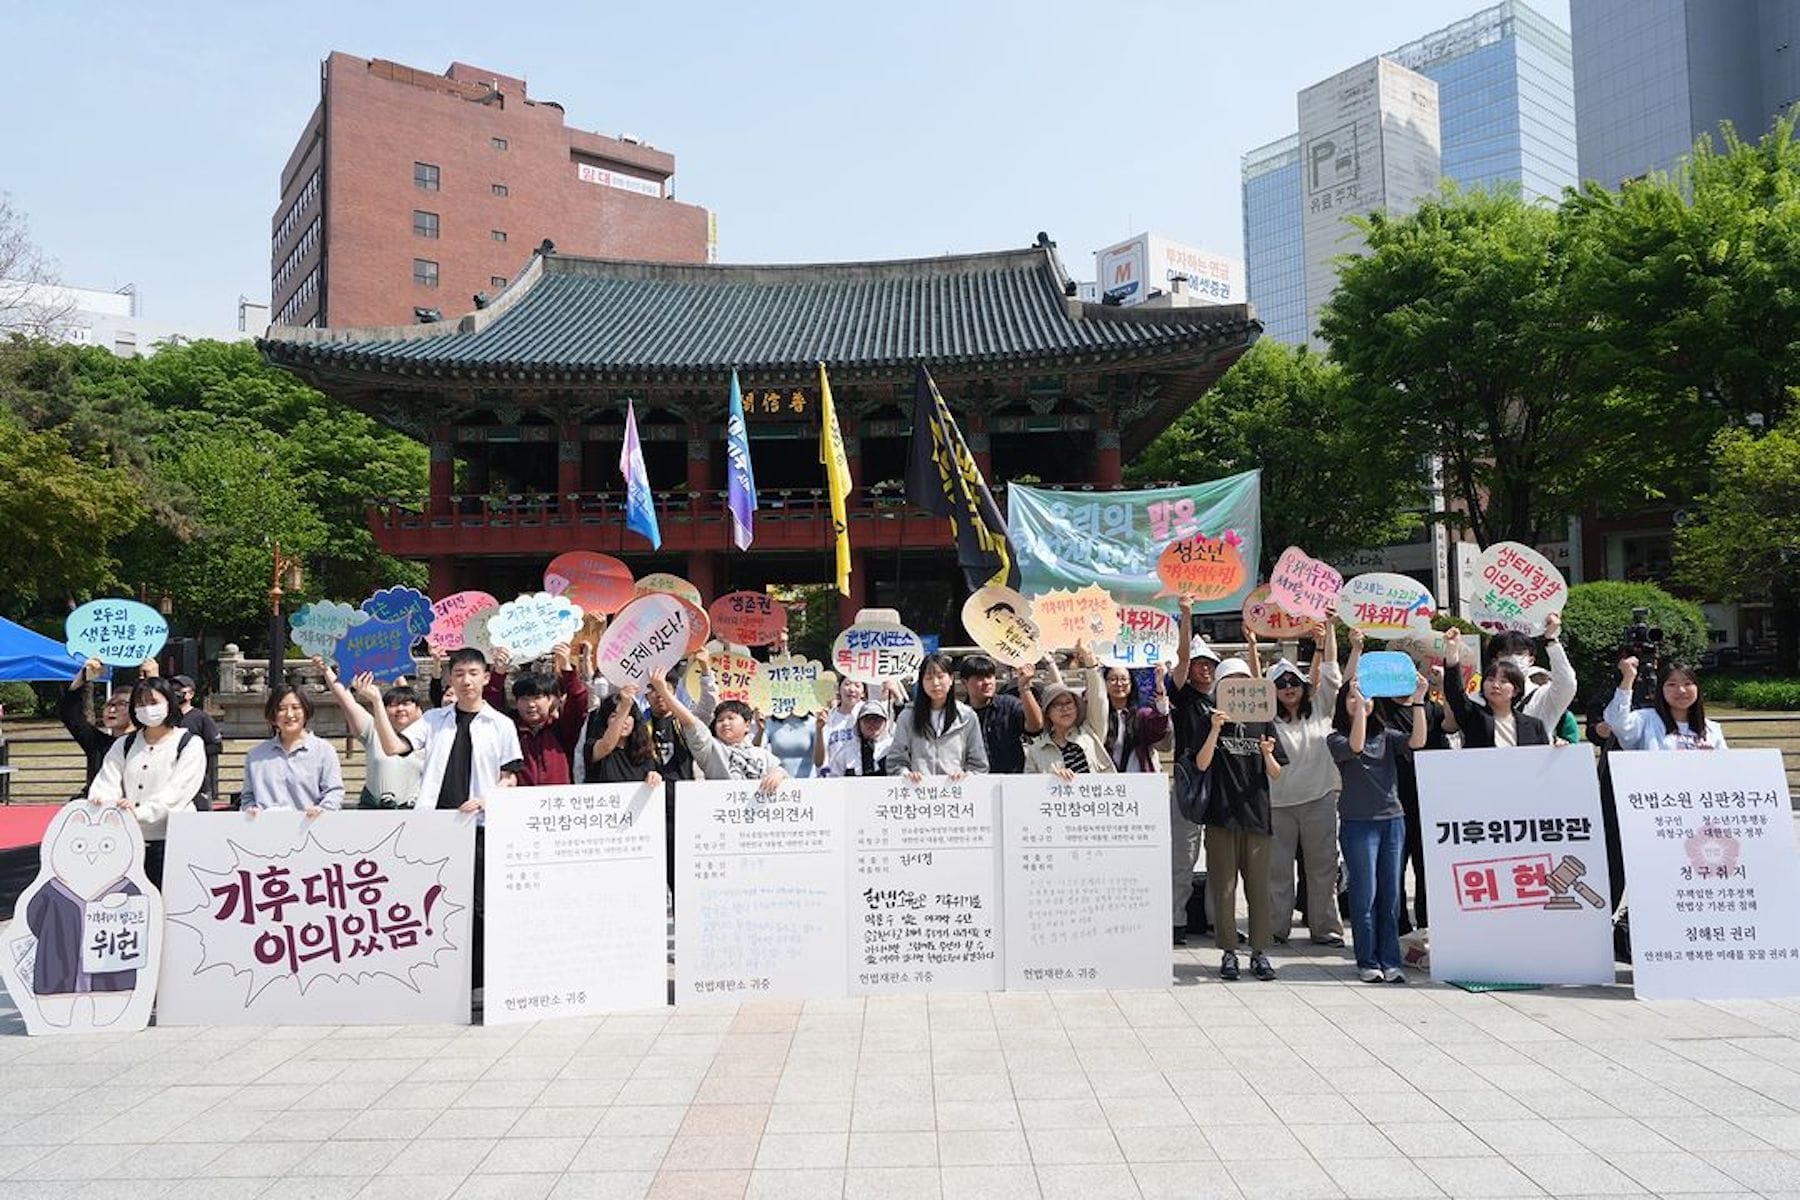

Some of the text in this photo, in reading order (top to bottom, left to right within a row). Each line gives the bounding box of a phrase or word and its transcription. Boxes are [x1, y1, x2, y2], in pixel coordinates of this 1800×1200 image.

[1498, 547, 1561, 600] 생태학살
[729, 595, 772, 615] 생존권
[1485, 589, 1522, 619] 녹색당
[93, 607, 128, 622] 모두의
[1353, 602, 1409, 627] 기후위기
[80, 624, 136, 643] 생존권을
[726, 789, 801, 804] 기후 헌법소원
[887, 785, 963, 800] 기후 헌법소원
[1050, 784, 1126, 798] 기후 헌법소원
[1628, 790, 1779, 810] 헌법소원 심판청구서
[540, 794, 621, 810] 기후 헌법소원
[875, 802, 975, 820] 국민참여의견서
[1040, 801, 1140, 817] 국민참여의견서
[526, 811, 633, 832] 국민참여의견서
[713, 806, 814, 824] 국민참여의견서
[1654, 816, 1683, 827] 청구인
[1436, 818, 1592, 844] 기후위기방관
[1704, 828, 1742, 839] 대한민국
[863, 887, 927, 909] 헌법소원은
[254, 884, 443, 974] 이의있음!
[1686, 926, 1757, 942] 침해된 권리
[91, 928, 140, 961] 위헌
[859, 972, 910, 984] 헌법재판소
[1023, 968, 1097, 980] 헌법재판소 귀중
[694, 980, 747, 992] 헌법재판소
